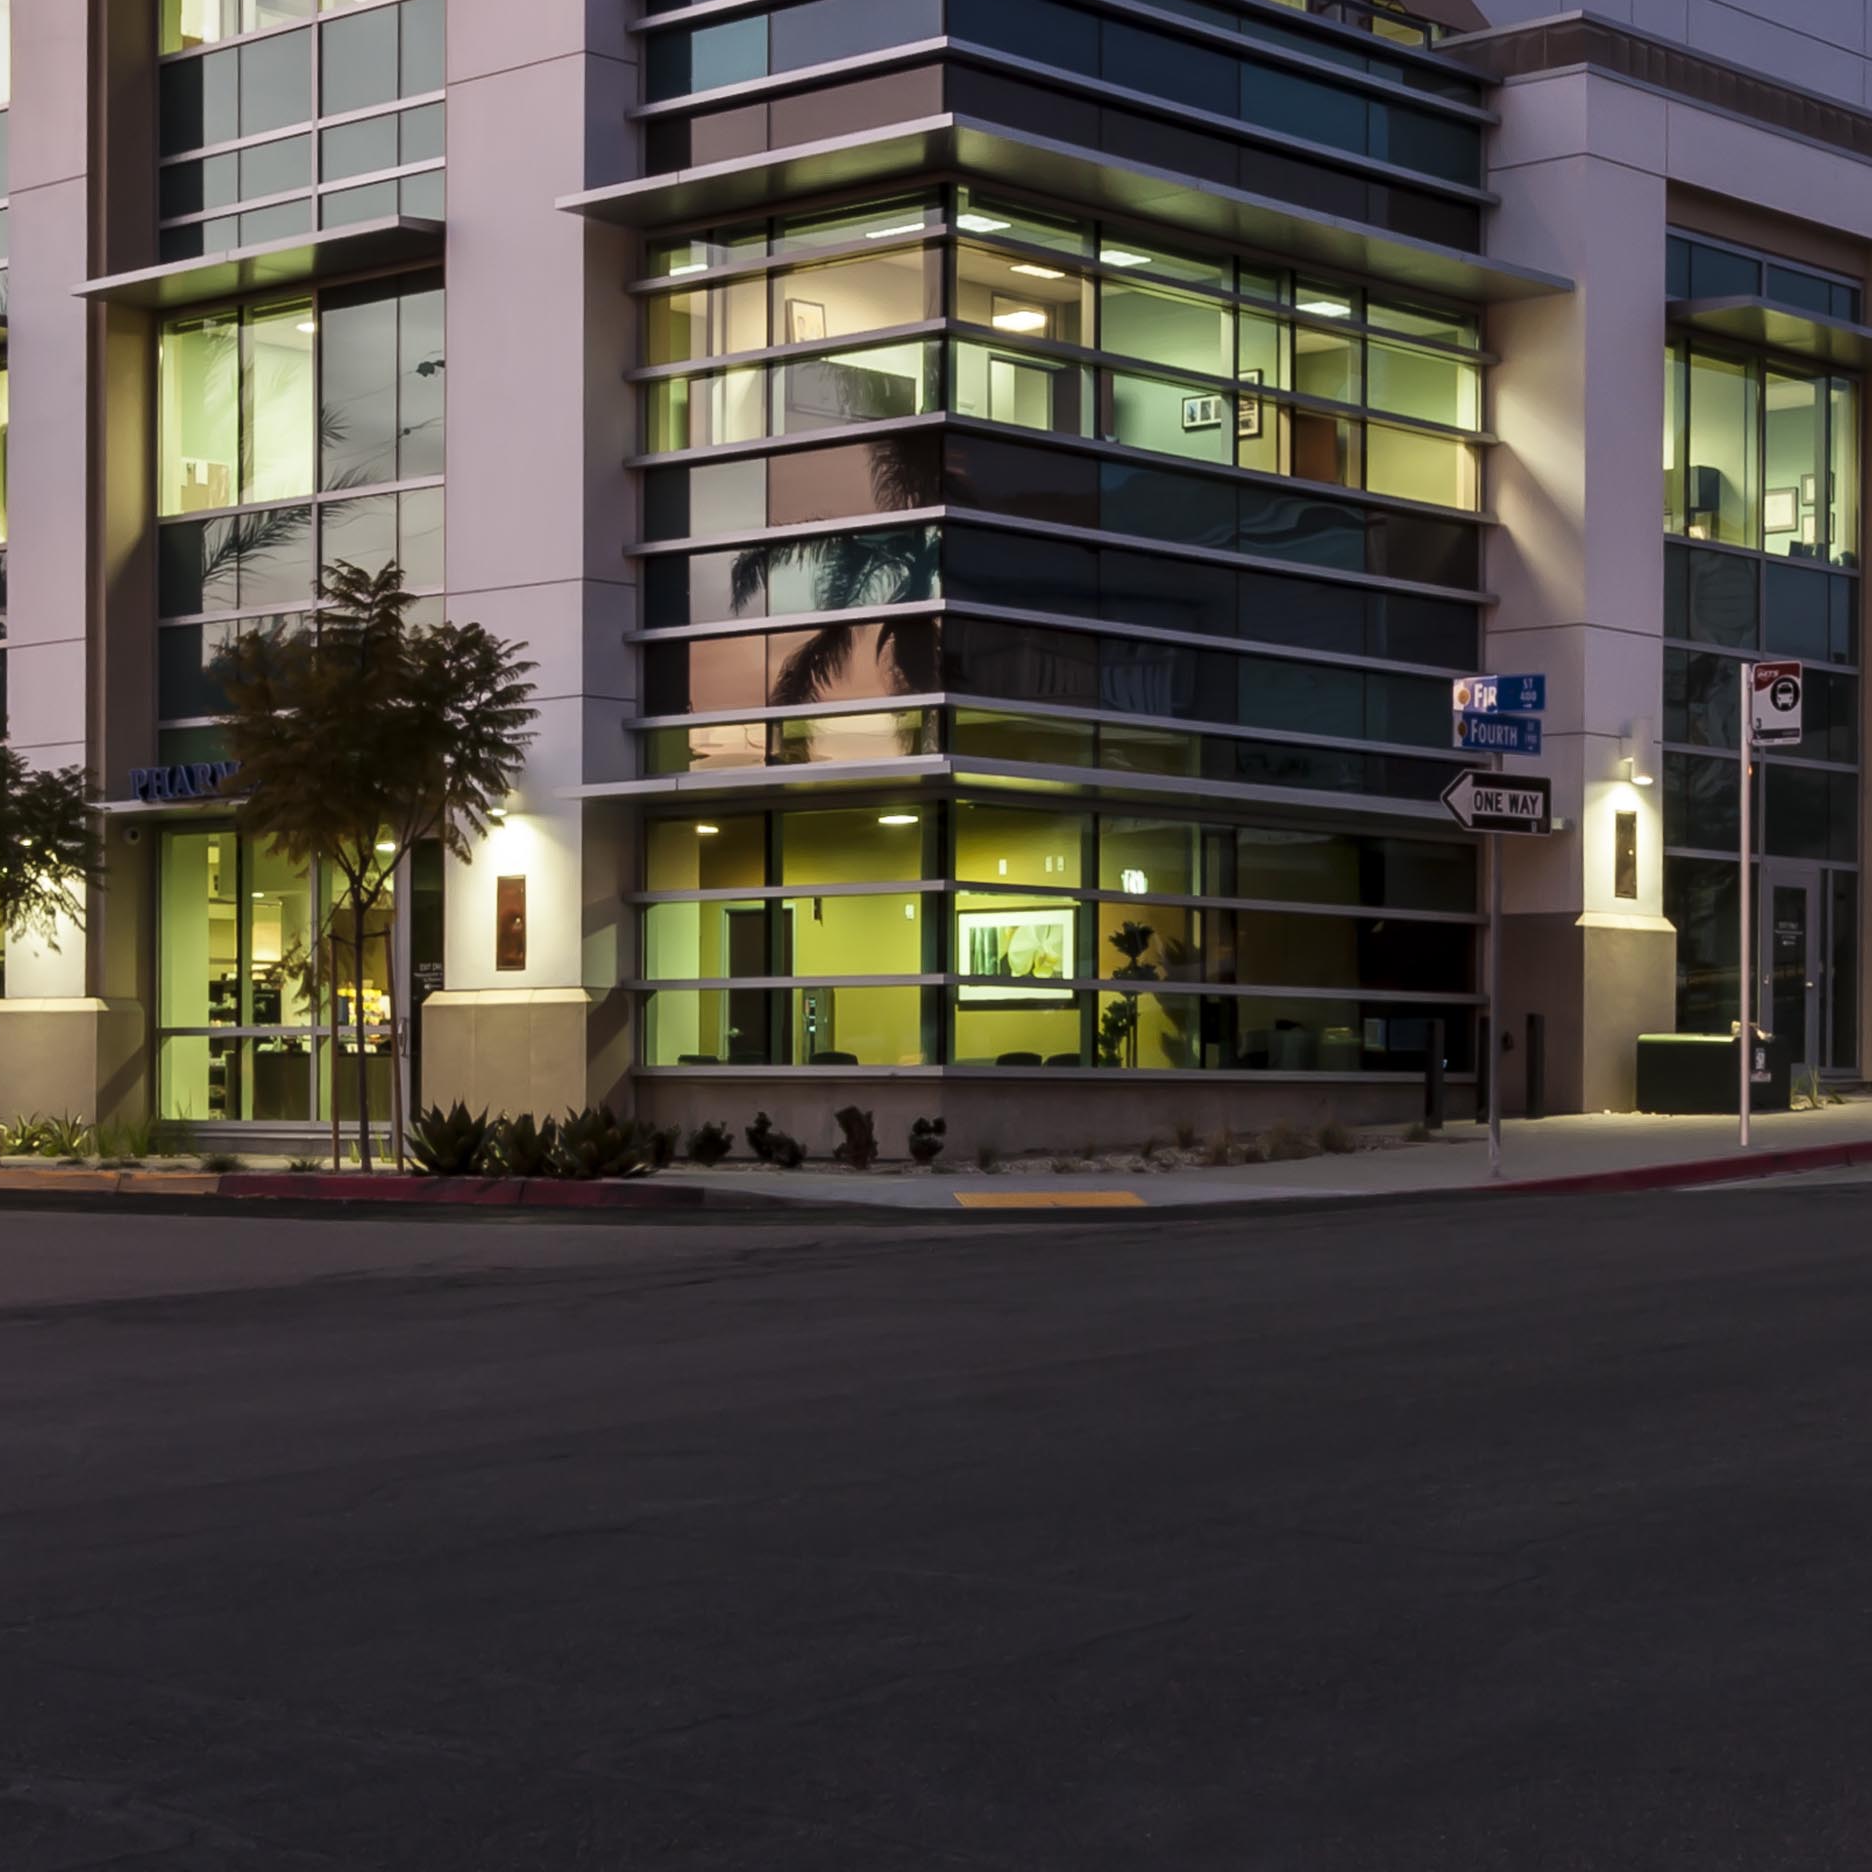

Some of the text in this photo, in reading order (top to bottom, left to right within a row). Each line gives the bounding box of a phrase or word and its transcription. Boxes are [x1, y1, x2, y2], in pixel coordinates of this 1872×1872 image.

[1471, 719, 1518, 747] FOURTH
[1473, 790, 1539, 815] ONE WAY
